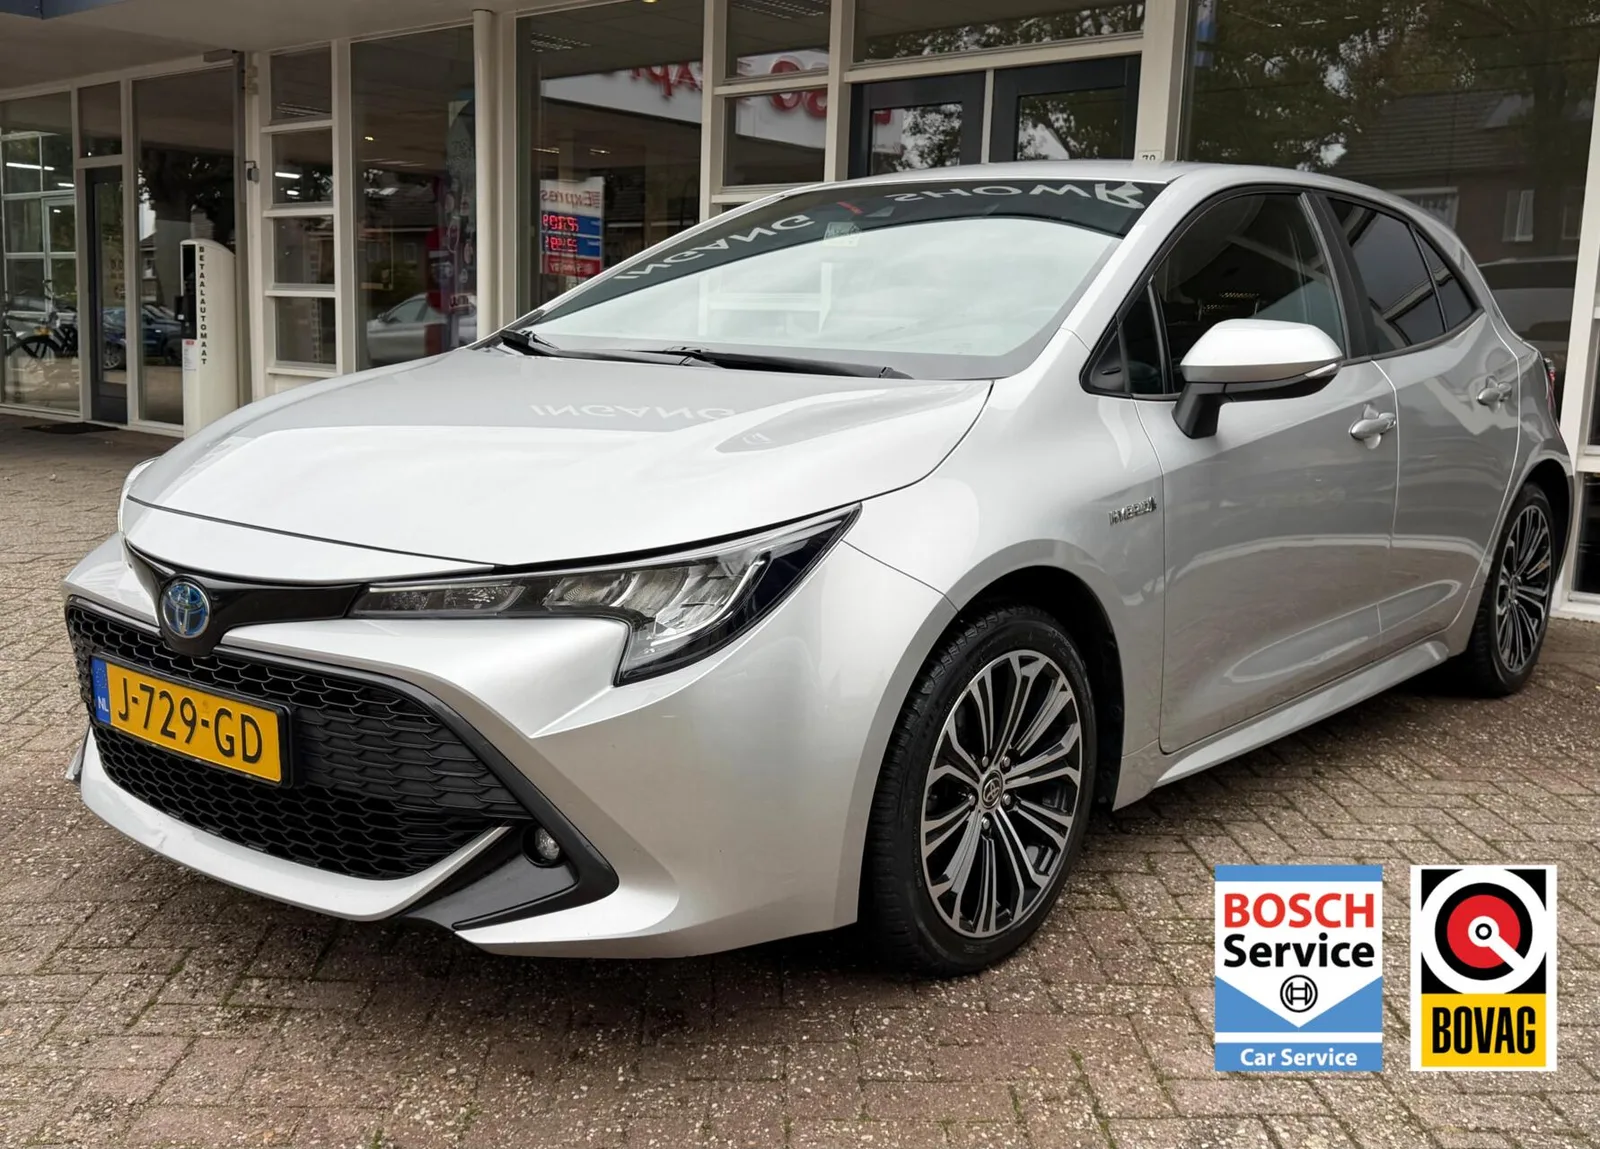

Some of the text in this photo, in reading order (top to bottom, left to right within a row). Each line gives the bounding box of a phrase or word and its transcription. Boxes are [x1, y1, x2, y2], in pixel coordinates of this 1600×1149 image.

[199, 246, 208, 365] BETAALAUTOMAAT
[97, 695, 109, 713] NL
[118, 677, 263, 764] J-729-GD
